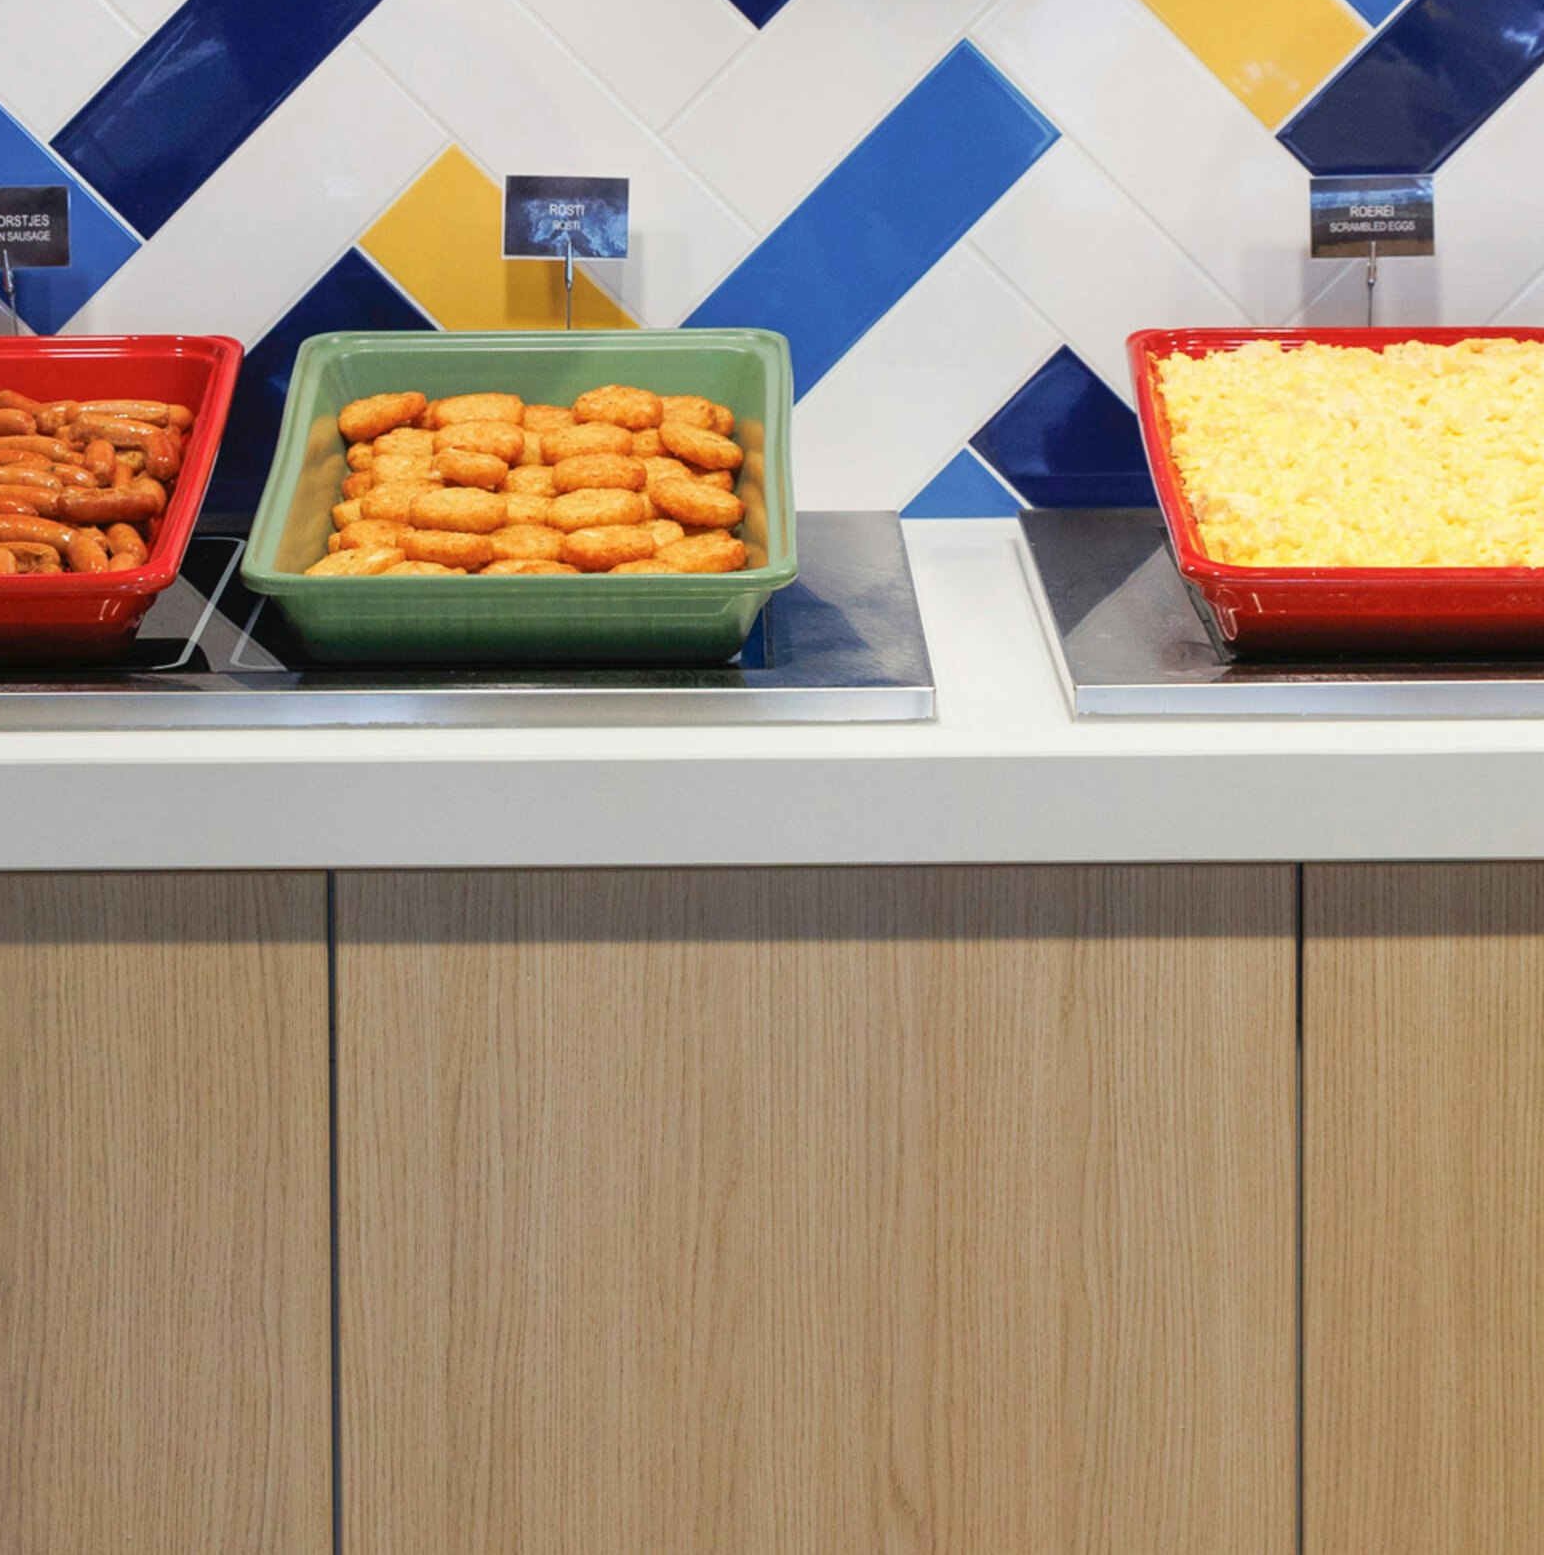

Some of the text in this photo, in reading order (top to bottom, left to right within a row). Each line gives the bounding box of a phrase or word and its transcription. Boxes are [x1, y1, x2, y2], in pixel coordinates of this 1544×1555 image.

[1350, 205, 1395, 217] ROEREI
[1329, 220, 1416, 233] SCRAMBLED EGGS
[7, 230, 51, 242] SAUSAGE
